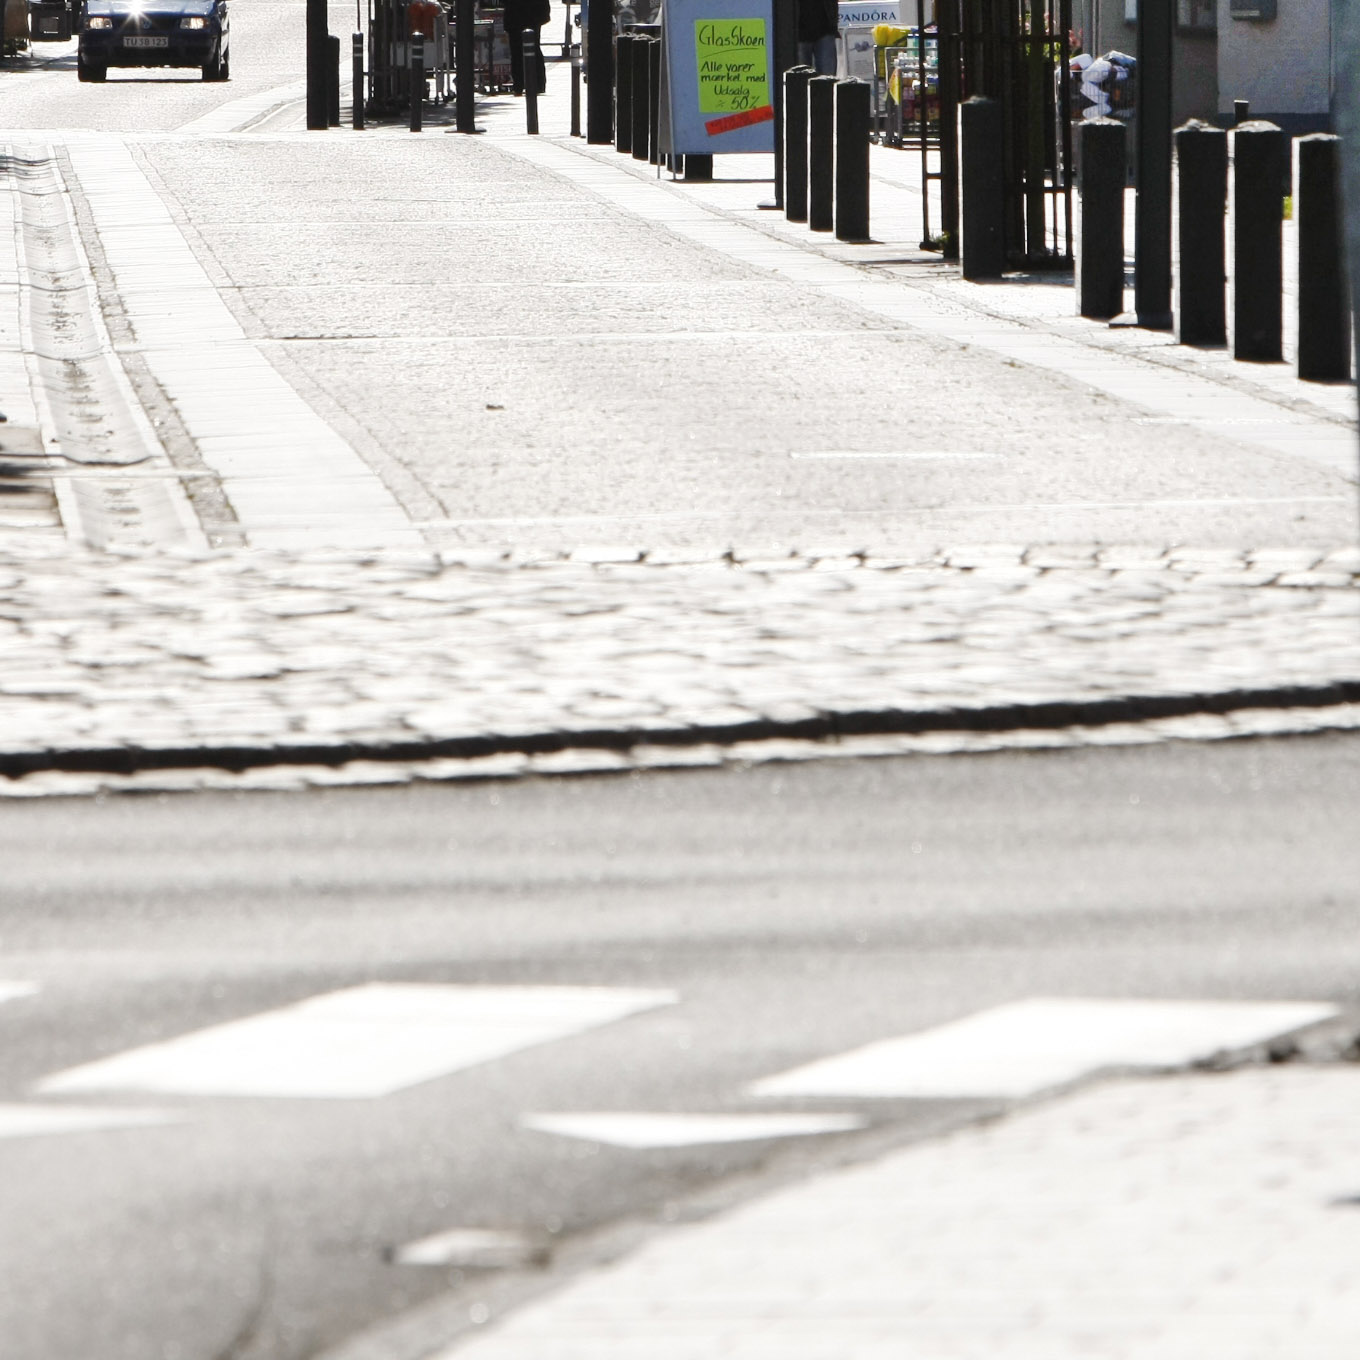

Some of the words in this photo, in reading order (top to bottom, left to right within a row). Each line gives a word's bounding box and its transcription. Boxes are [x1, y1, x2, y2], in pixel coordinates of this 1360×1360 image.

[700, 61, 723, 72] Alle
[725, 63, 755, 73] varer
[746, 73, 766, 82] med
[714, 84, 750, 97] Udsalg
